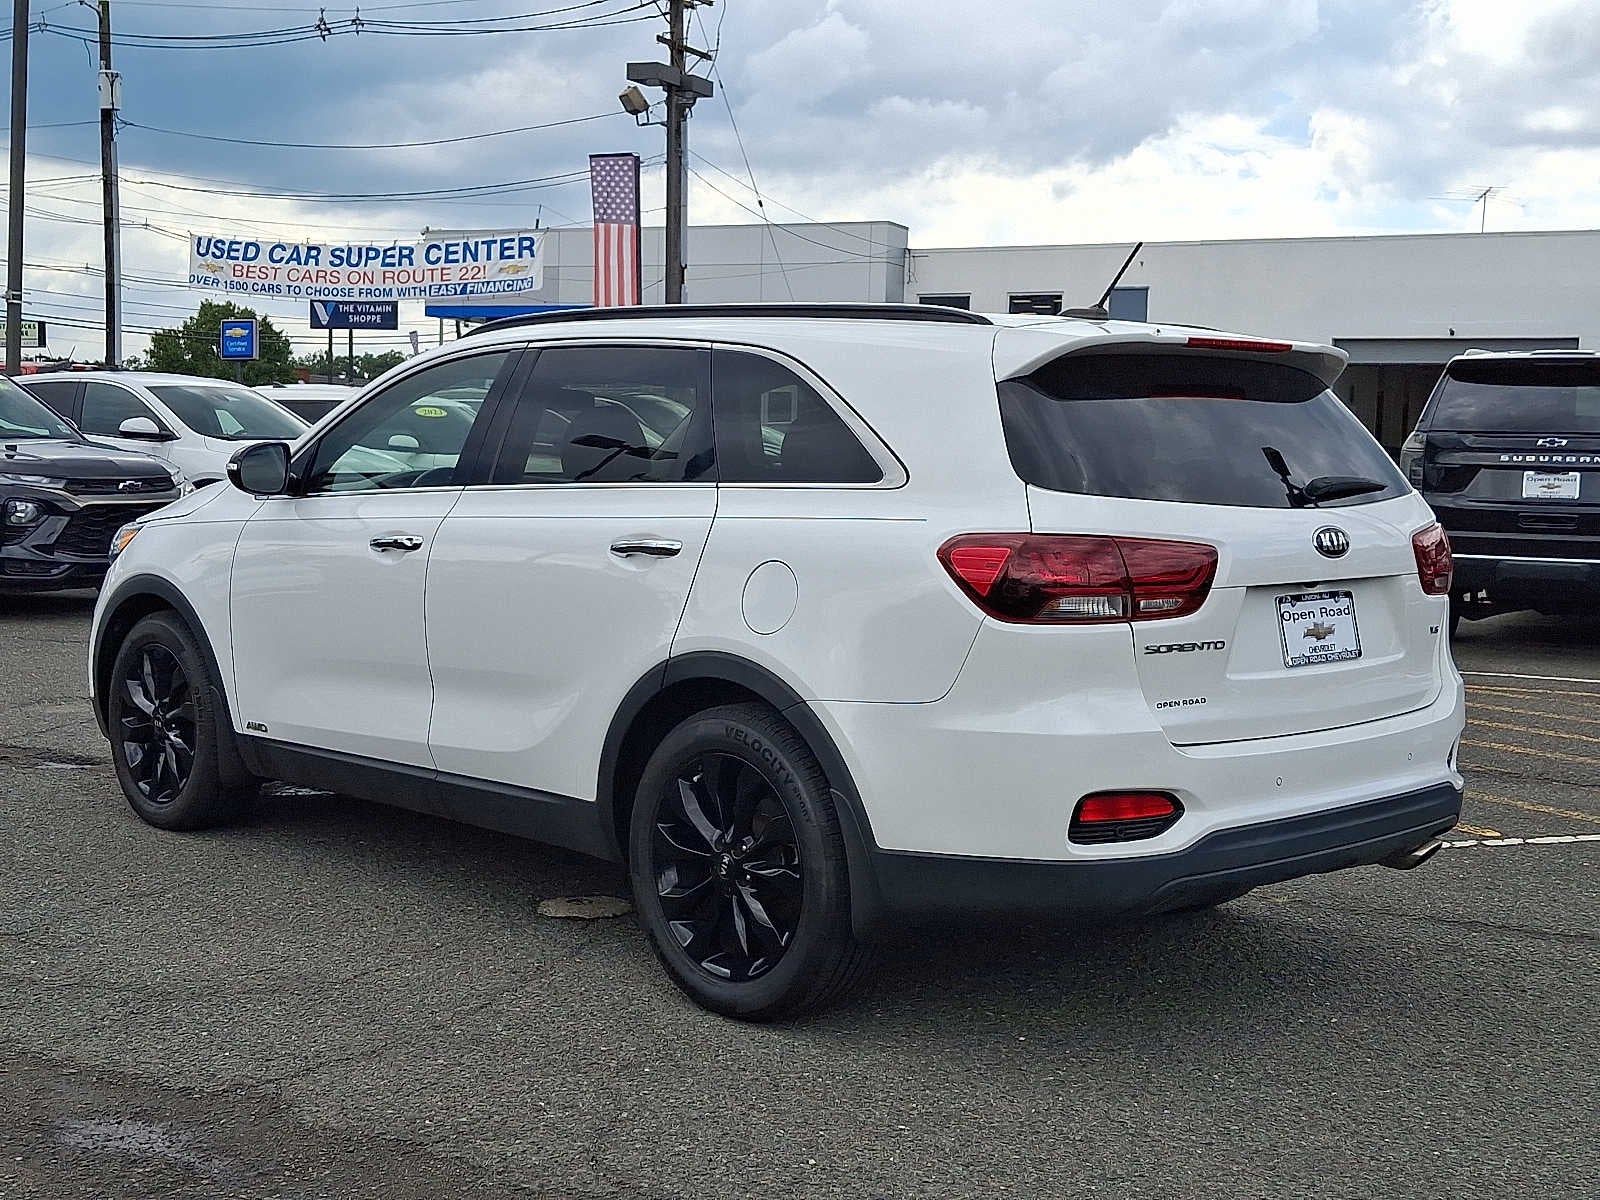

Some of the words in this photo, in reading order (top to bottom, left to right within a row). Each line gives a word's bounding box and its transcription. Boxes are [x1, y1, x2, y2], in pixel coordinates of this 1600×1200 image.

[195, 237, 260, 262] USED
[268, 244, 322, 267] CAR
[328, 245, 415, 268] SUPER
[424, 237, 536, 266] CENTER
[232, 264, 282, 281] BEST
[286, 267, 341, 284] CARS
[347, 270, 375, 285] ON
[382, 267, 452, 285] ROUTE
[458, 265, 487, 281] 22!
[189, 274, 220, 288] OVER
[223, 280, 249, 291] 1500
[251, 282, 282, 294] CARS
[286, 284, 301, 296] TO
[305, 286, 355, 298] CHOOSE
[358, 287, 393, 298] FROM
[396, 286, 427, 298] WITH
[430, 283, 464, 297] EASY
[467, 277, 533, 295] FINANCING
[338, 304, 354, 312] THE
[357, 304, 392, 313] VITAMIN
[348, 314, 382, 323] SHOPPE
[1318, 532, 1348, 551] KIA
[1281, 609, 1316, 624] Open
[1319, 604, 1351, 618] Road
[1143, 640, 1226, 655] SORENTO
[1292, 656, 1309, 665] OPEN
[1309, 654, 1326, 664] ROAD
[1327, 650, 1360, 661] CHEVROLET
[1156, 700, 1181, 709] OPEN
[1182, 697, 1207, 706] ROAD
[245, 721, 269, 733] AWD
[725, 725, 794, 784] VELOCITY
